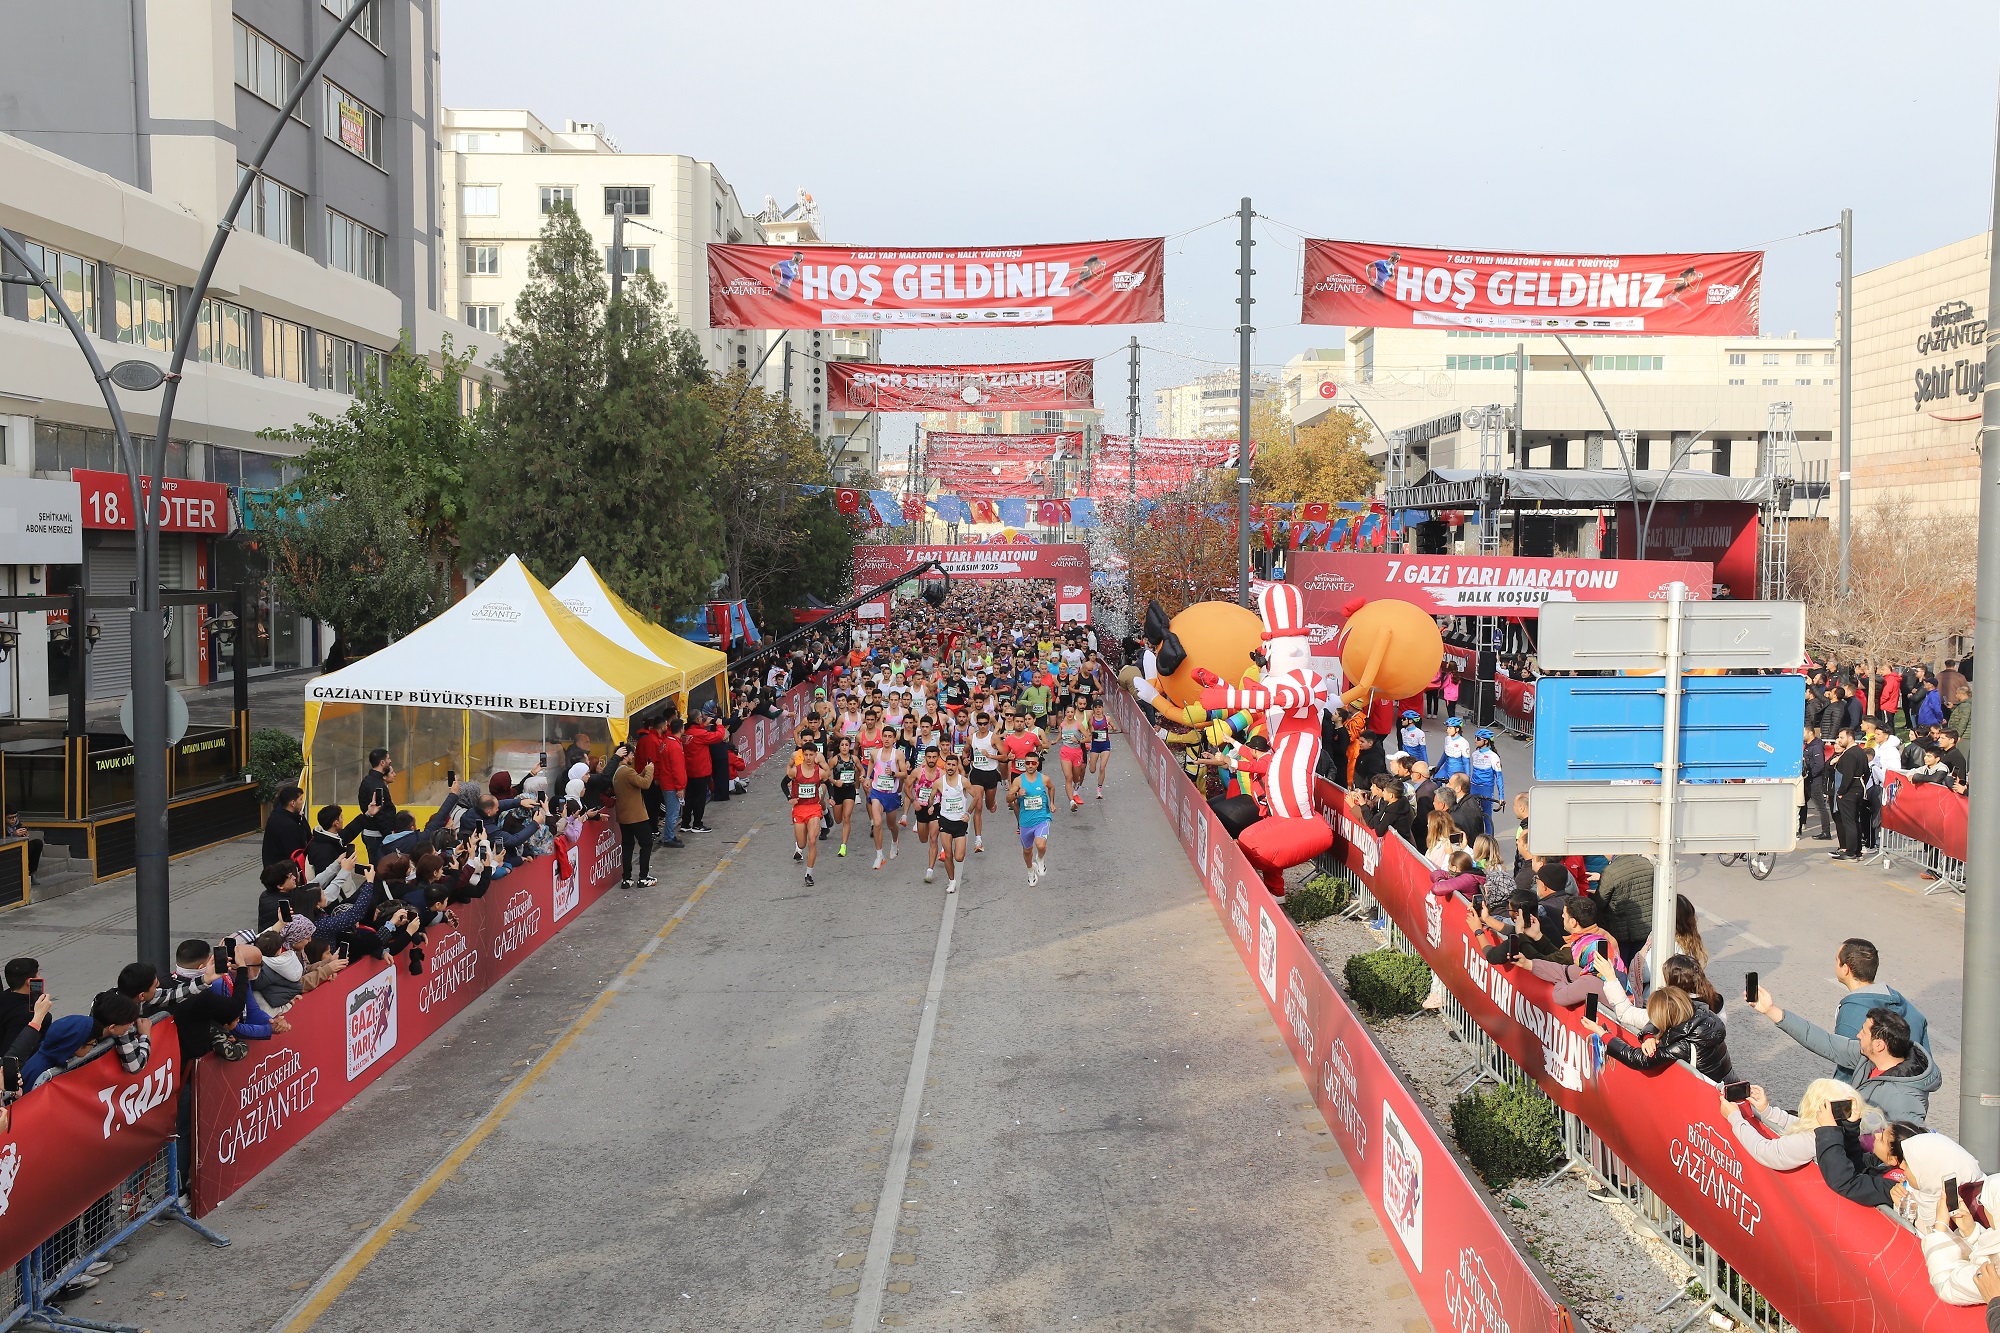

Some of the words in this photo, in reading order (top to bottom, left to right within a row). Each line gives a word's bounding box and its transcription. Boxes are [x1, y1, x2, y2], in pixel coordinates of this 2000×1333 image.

[898, 251, 944, 260] MARATONU
[957, 251, 978, 259] HALK
[1474, 256, 1494, 265] YARI
[1495, 257, 1540, 267] MARATONU
[1553, 259, 1575, 267] HALK
[802, 264, 883, 306] HOŞ
[1396, 266, 1477, 311] HOŞ
[1914, 363, 1954, 412] Şehir
[38, 511, 73, 523] ŞEHİTKAMİL
[89, 490, 126, 525] 18.
[25, 524, 48, 534] ABONE
[48, 523, 73, 534] MERKEZİ
[1684, 525, 1732, 548] MARATONU
[956, 563, 979, 572] KASIM
[981, 563, 999, 572] 2025
[973, 550, 1038, 562] MARATONU
[1456, 566, 1501, 586] YARI
[1506, 567, 1619, 589] MARATONU
[1457, 591, 1492, 603] HALK
[1497, 591, 1550, 606] KOŞUSU
[313, 686, 404, 702] GAZİANTEP
[409, 689, 514, 708] BÜYÜKŞEHİR
[519, 698, 611, 714] BELEDİYESİ
[96, 757, 121, 771] TAVUK
[430, 935, 468, 975] BÜYÜKŞEHİR
[418, 949, 478, 1014] GAZİANTEP
[1490, 965, 1513, 1018] YARI
[1514, 989, 1591, 1081] MARATONU
[351, 1033, 371, 1062] YARI
[239, 1051, 302, 1111] BÜYÜKŞEHİR
[1550, 1057, 1565, 1082] 2025
[218, 1066, 319, 1165] GAZİANTEP
[1687, 1122, 1744, 1185] BÜYÜKŞEHİR
[1669, 1138, 1762, 1237] GAZİANTEP
